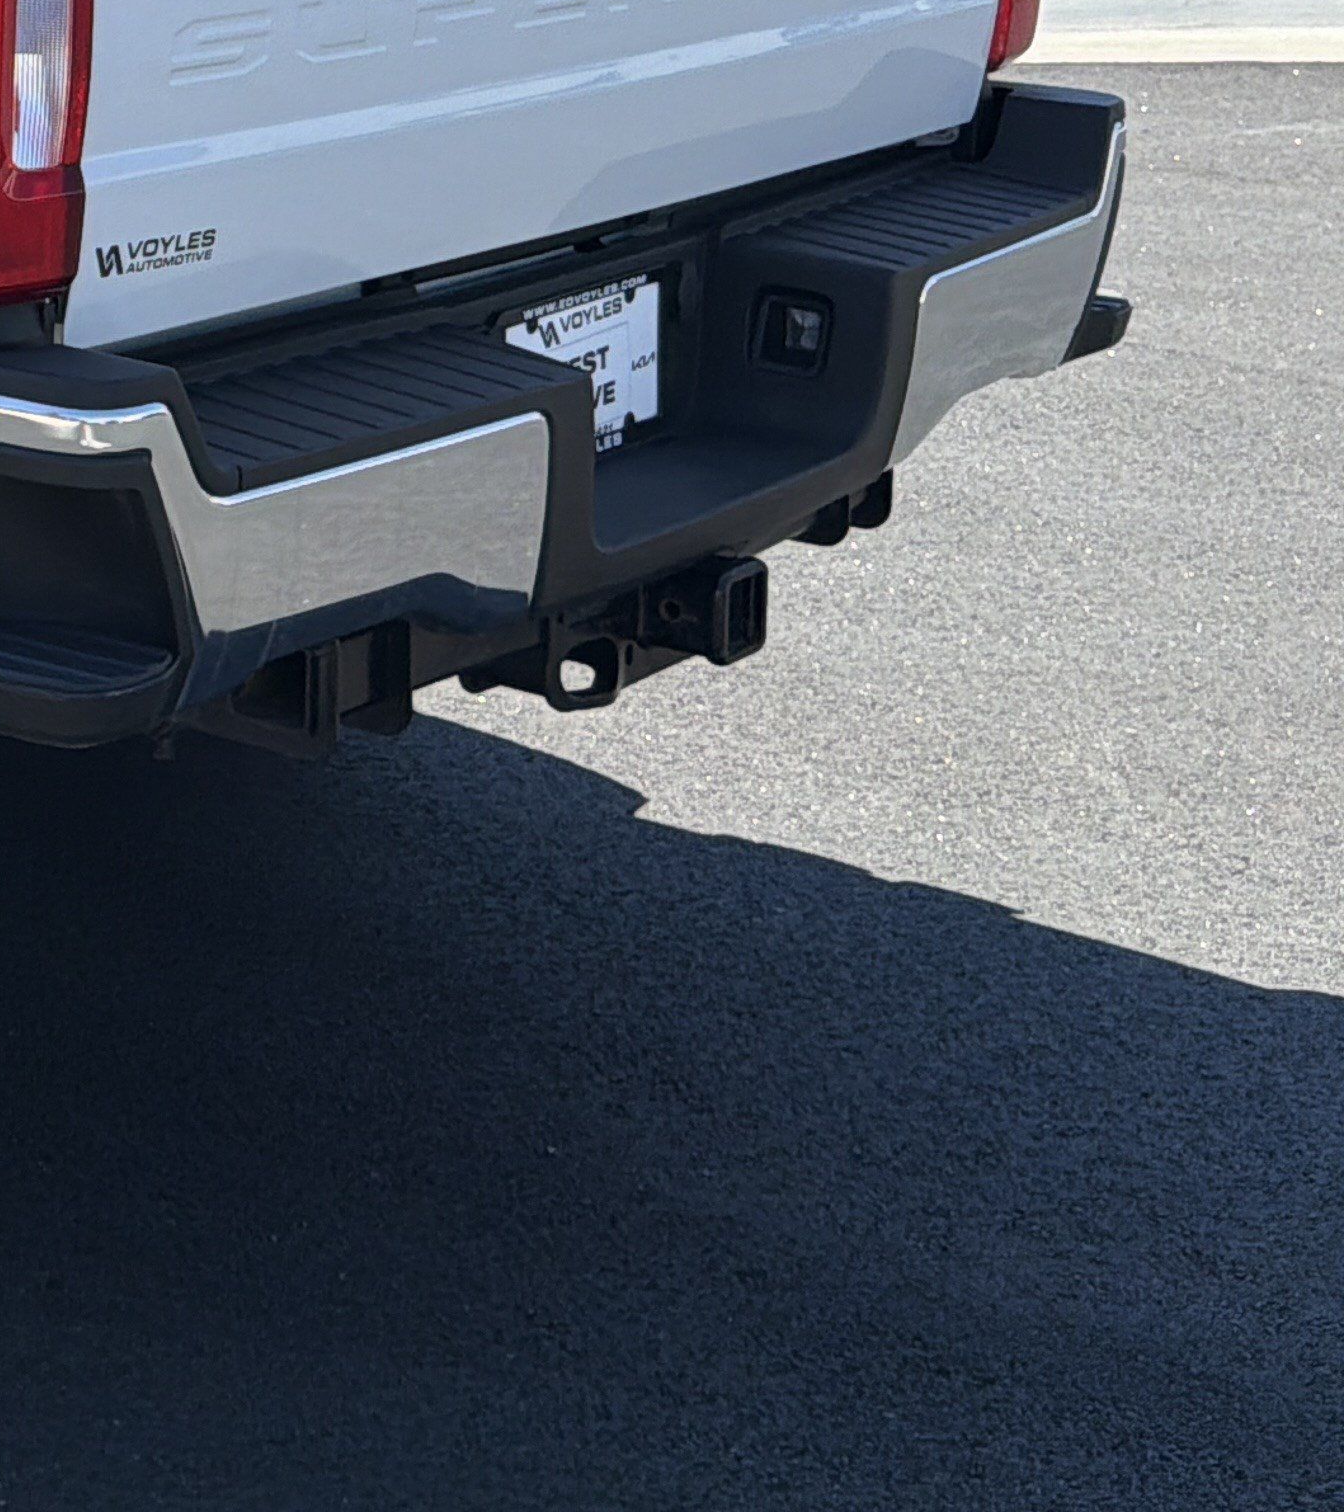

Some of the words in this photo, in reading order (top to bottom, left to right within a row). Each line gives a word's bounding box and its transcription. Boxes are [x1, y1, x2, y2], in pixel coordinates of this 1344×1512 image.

[127, 228, 217, 260] VOYLES
[125, 248, 213, 274] AUTOMOTIVE
[560, 296, 623, 333] VOYLES
